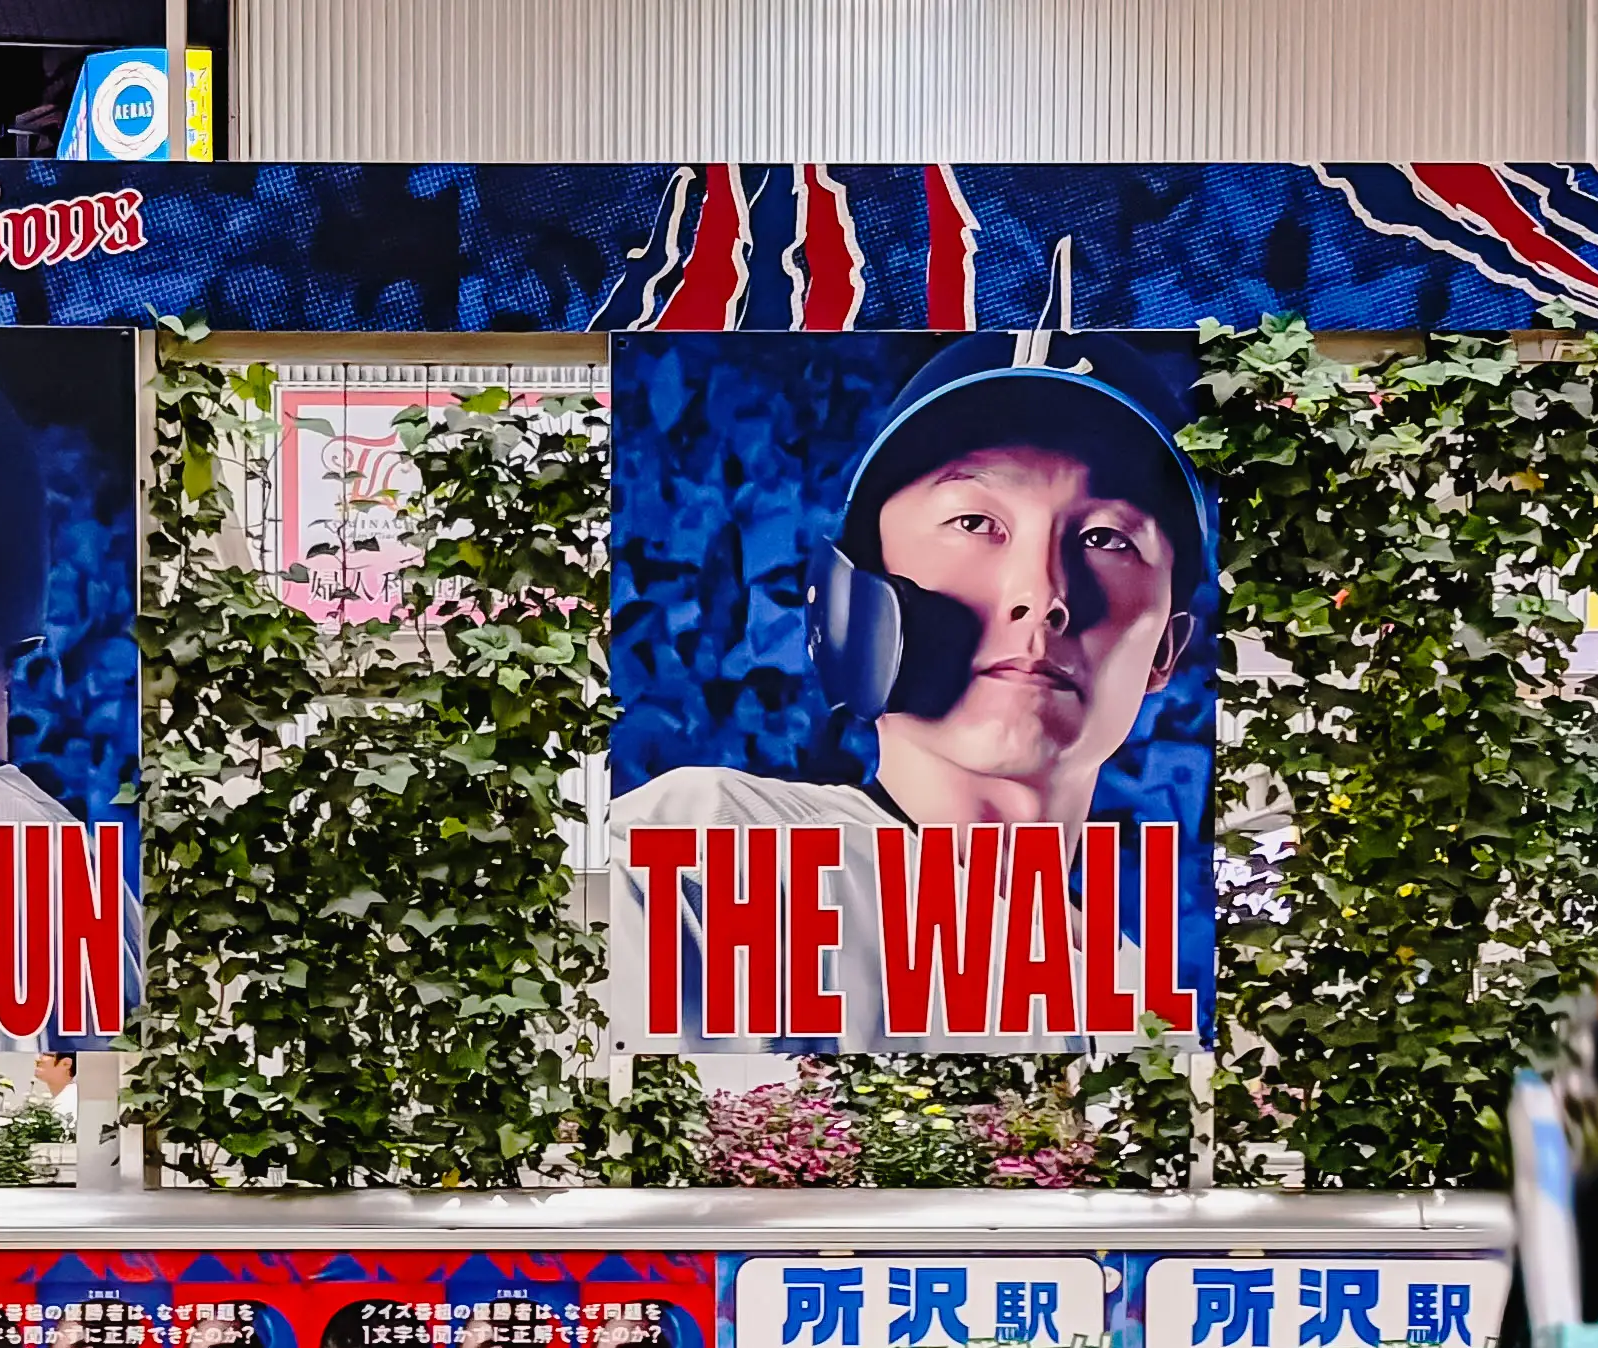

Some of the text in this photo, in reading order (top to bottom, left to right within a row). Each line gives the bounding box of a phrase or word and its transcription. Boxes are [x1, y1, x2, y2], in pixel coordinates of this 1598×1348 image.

[628, 822, 1198, 1038] THE WALL
[360, 1303, 662, 1322] クイズ番組の優勝者は、なぜ問題を
[362, 1325, 661, 1344] 1文字も聞かずに正解できたのか?
[782, 1267, 1060, 1347] 所沢駅
[1191, 1268, 1471, 1347] 所沢駅
